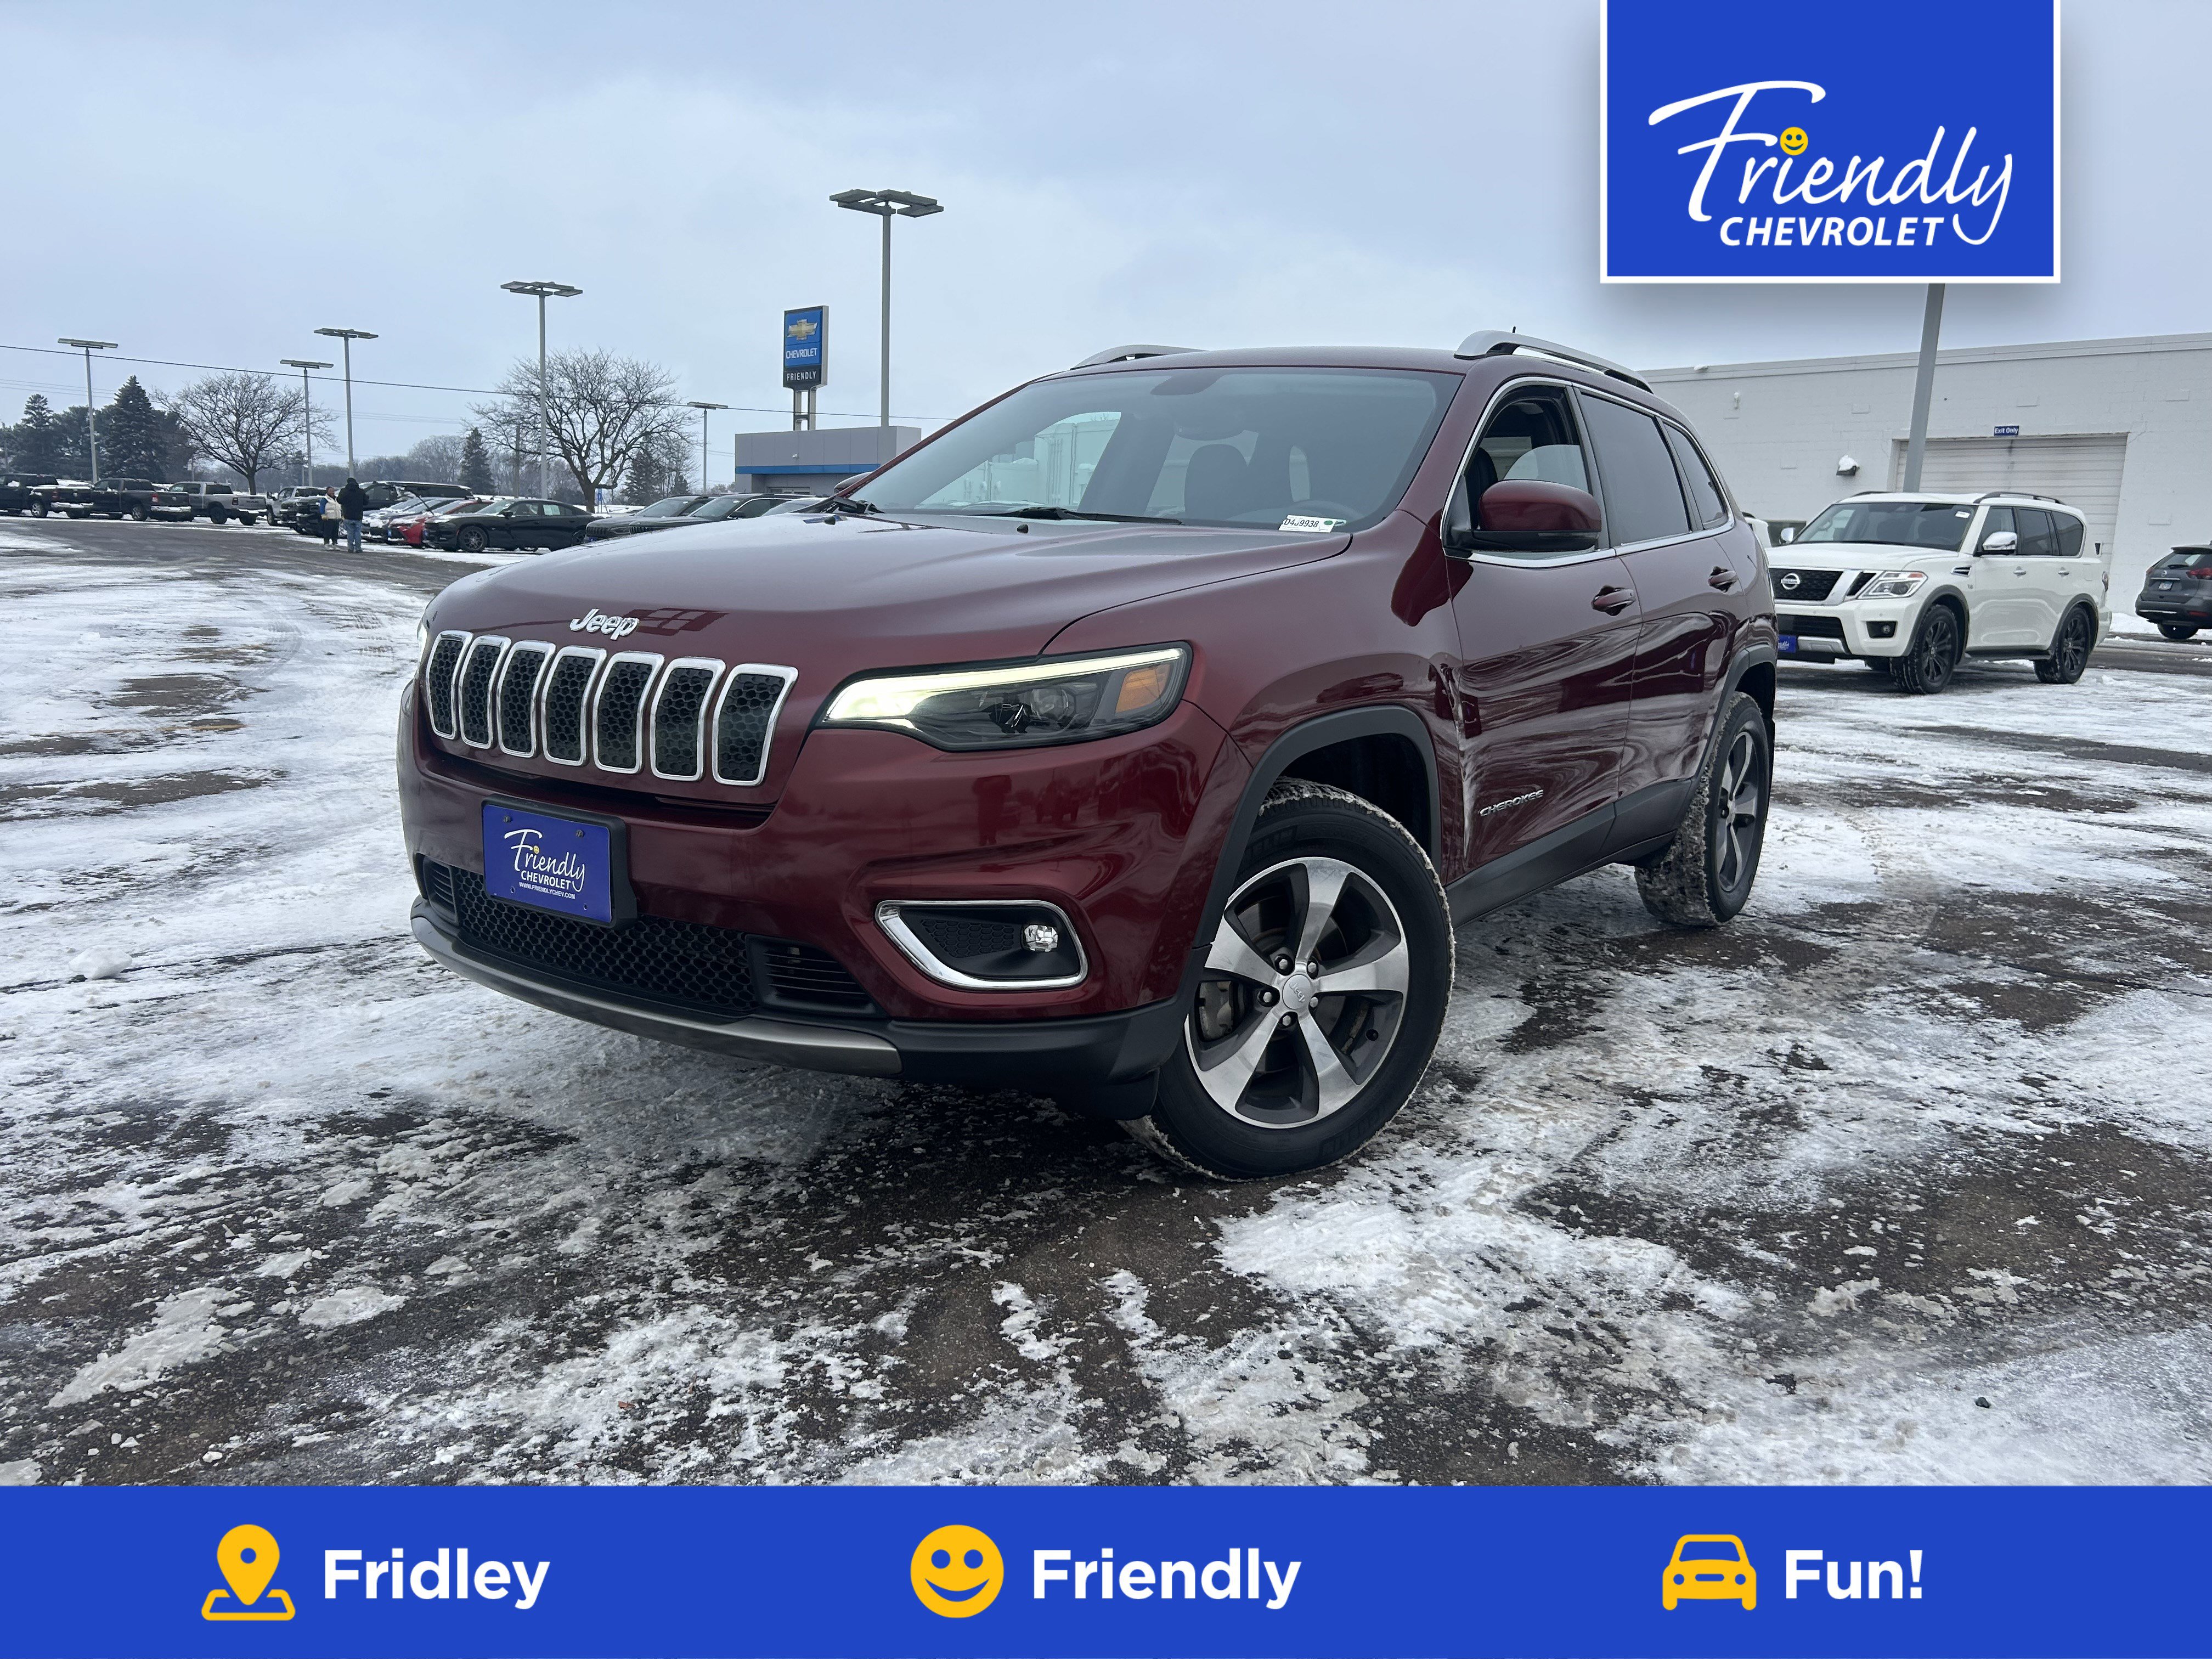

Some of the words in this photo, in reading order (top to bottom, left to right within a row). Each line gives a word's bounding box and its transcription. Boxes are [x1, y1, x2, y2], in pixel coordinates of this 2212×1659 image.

[786, 348, 817, 359] CHEVROLET
[787, 371, 817, 381] FRIENDLY
[1283, 518, 1319, 528] D4J9938
[569, 608, 640, 641] Jeep
[1480, 789, 1544, 816] CHEROKEE
[504, 828, 585, 892] Friendly
[521, 870, 571, 890] CHEVROLET
[518, 882, 575, 900] WWW.FRIENDLYCHEV.COM
[1289, 983, 1306, 1003] Jeep
